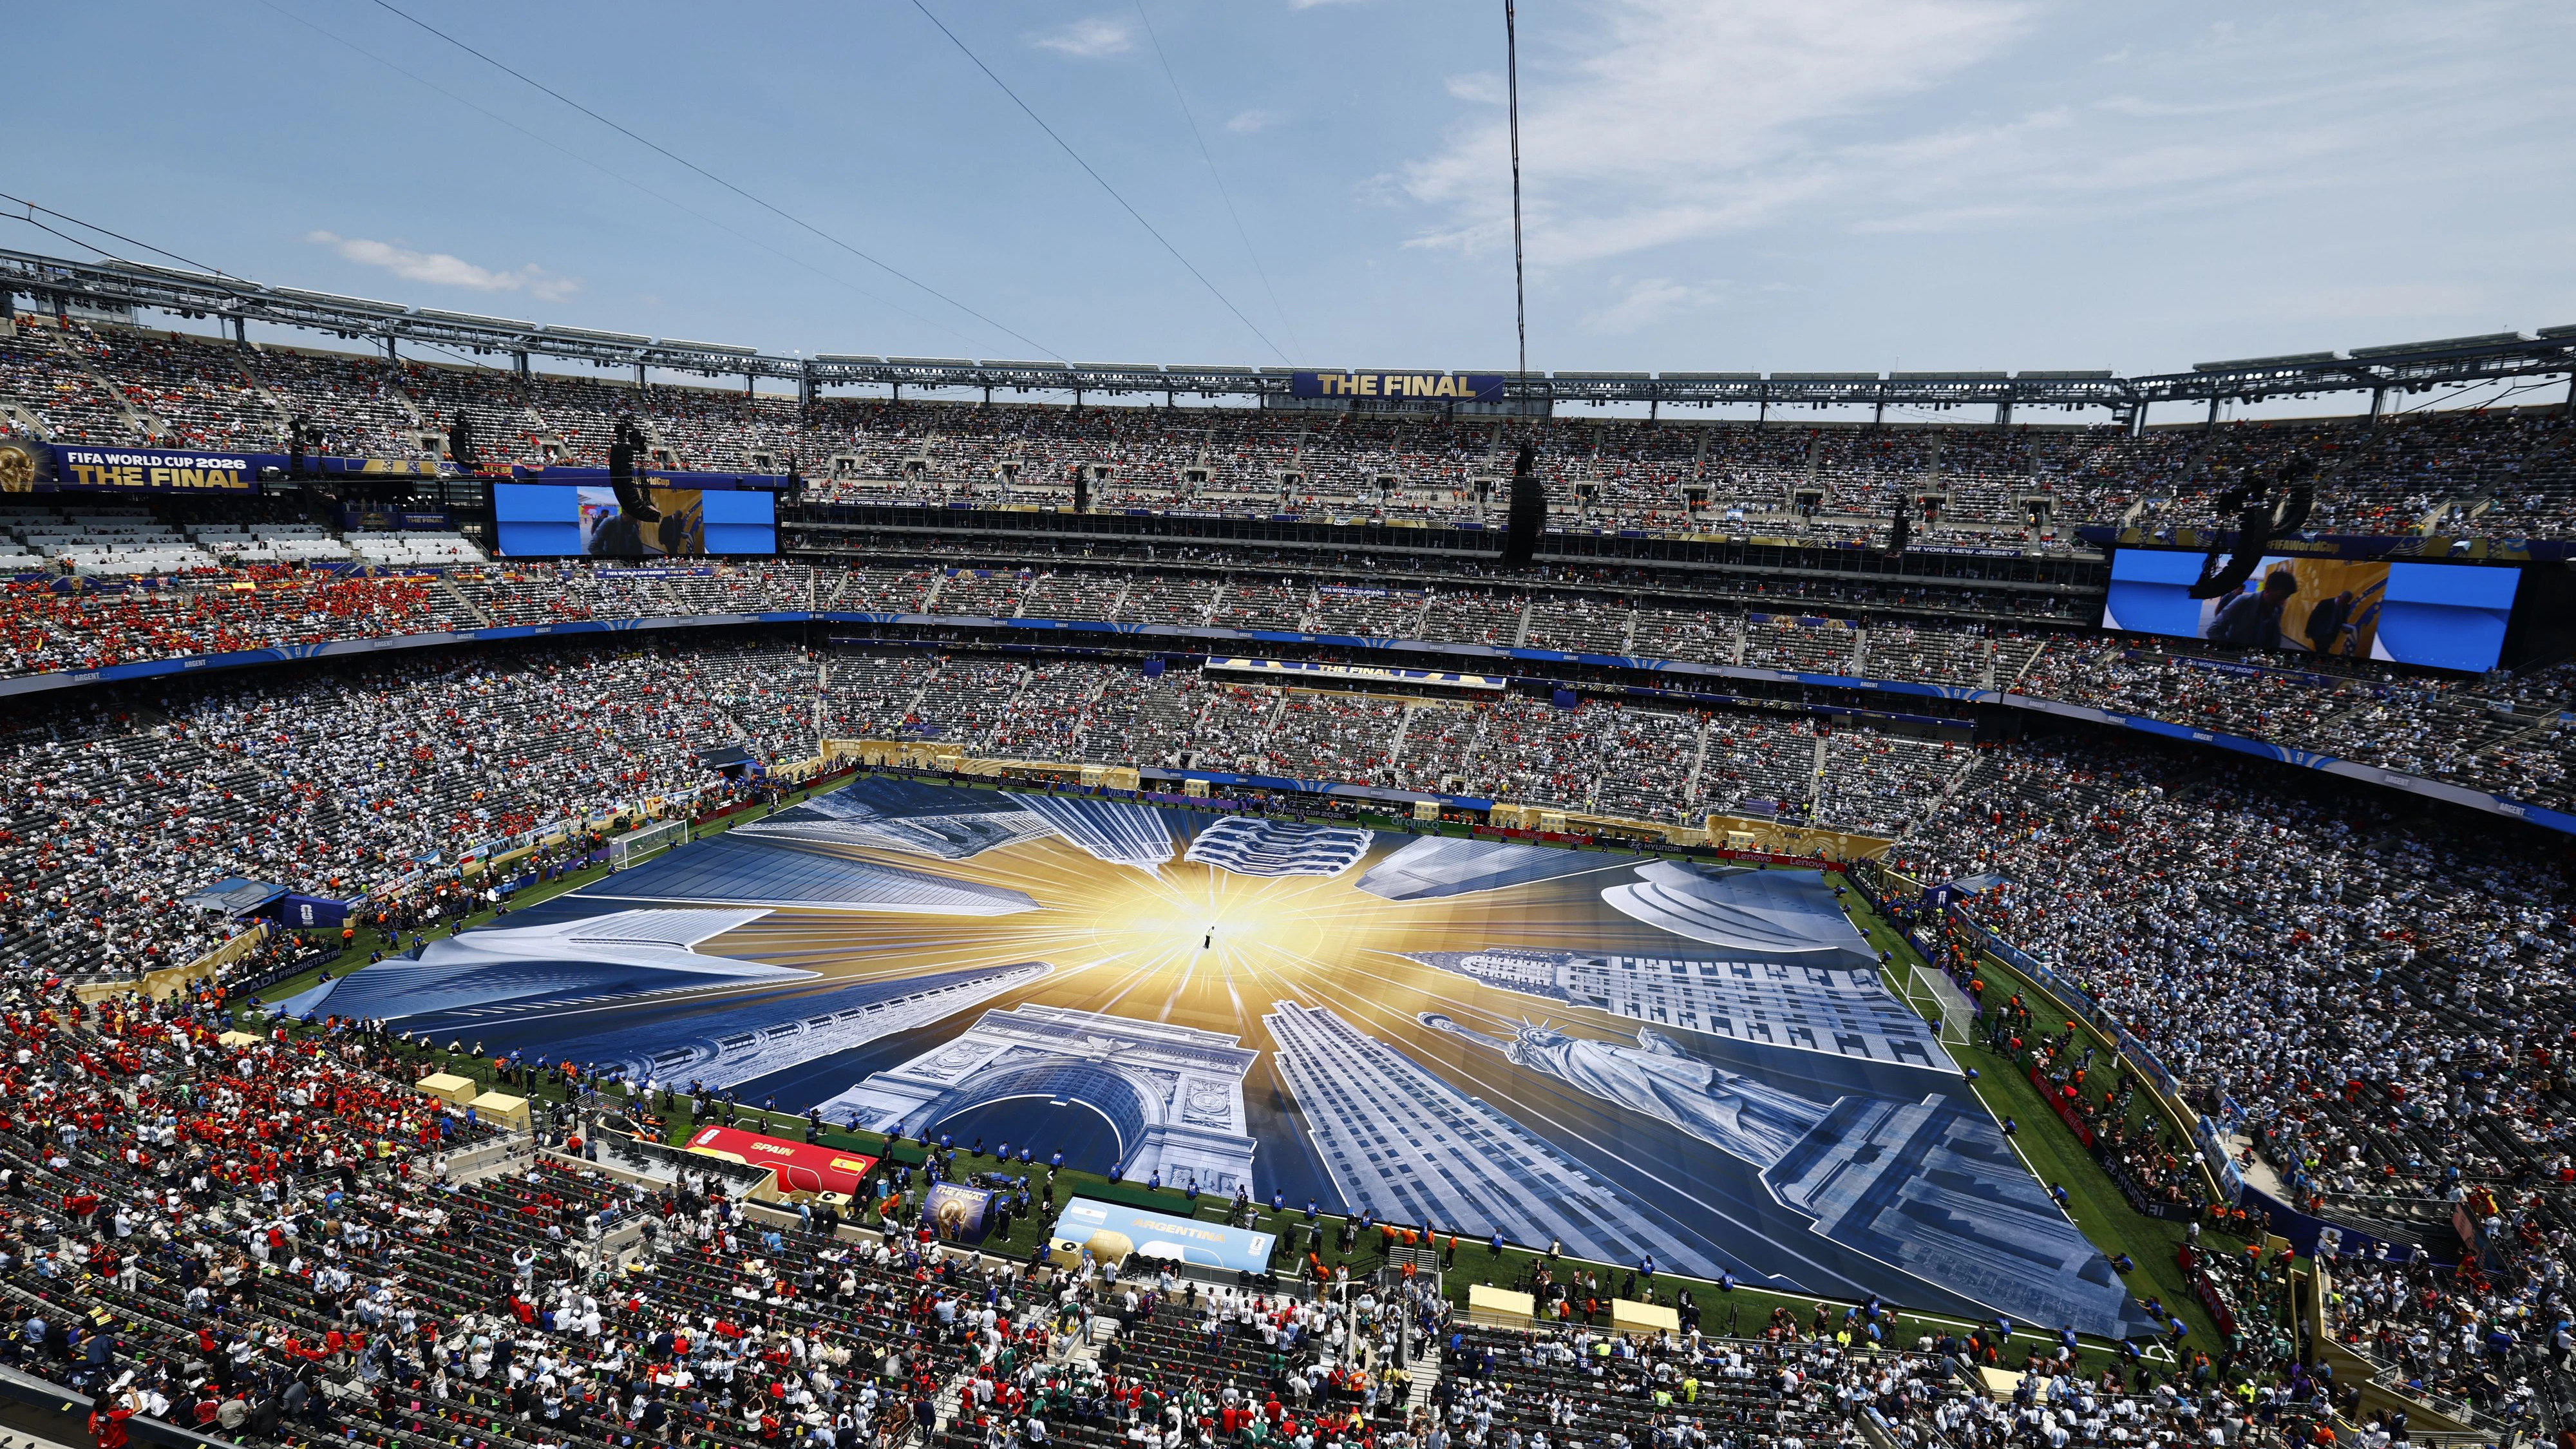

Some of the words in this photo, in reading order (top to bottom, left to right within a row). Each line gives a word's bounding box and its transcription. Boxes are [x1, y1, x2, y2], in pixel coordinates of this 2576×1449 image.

[1318, 375, 1378, 395] THE
[1384, 375, 1476, 397] FINAL
[68, 452, 105, 464] FIFA
[109, 454, 162, 467] WORLD
[164, 457, 194, 468] CUP
[195, 458, 247, 470] 2026
[70, 465, 144, 487] THE
[150, 468, 249, 488] FINAL
[184, 659, 206, 668] ARGENT
[2198, 661, 2221, 669] WORLD
[1318, 665, 1348, 673] THE
[1349, 667, 1394, 677] FINAL
[74, 672, 100, 683] ARGENT
[2107, 715, 2126, 724] ARGENT
[2192, 732, 2214, 742] ARGENT
[820, 772, 841, 784] Lenovo
[889, 768, 942, 778] PREDICTSTREET
[967, 774, 992, 783] QATAR
[996, 777, 1027, 787] AIRWAYS
[2384, 774, 2410, 787] ARGENT
[1064, 784, 1085, 794] VISA
[1107, 789, 1128, 799] VISA
[2498, 802, 2526, 816] ARGENT
[1391, 818, 1439, 829] aramco
[1644, 843, 1681, 852] HYUNDAI
[1736, 852, 1772, 862] Lenovo
[1790, 858, 1827, 869] Lenovo
[249, 974, 277, 992] ADI
[750, 1142, 795, 1156] SPAIN
[936, 1187, 954, 1197] THE
[954, 1190, 985, 1202] FINAL
[1132, 1218, 1226, 1244] ARGENTINA
